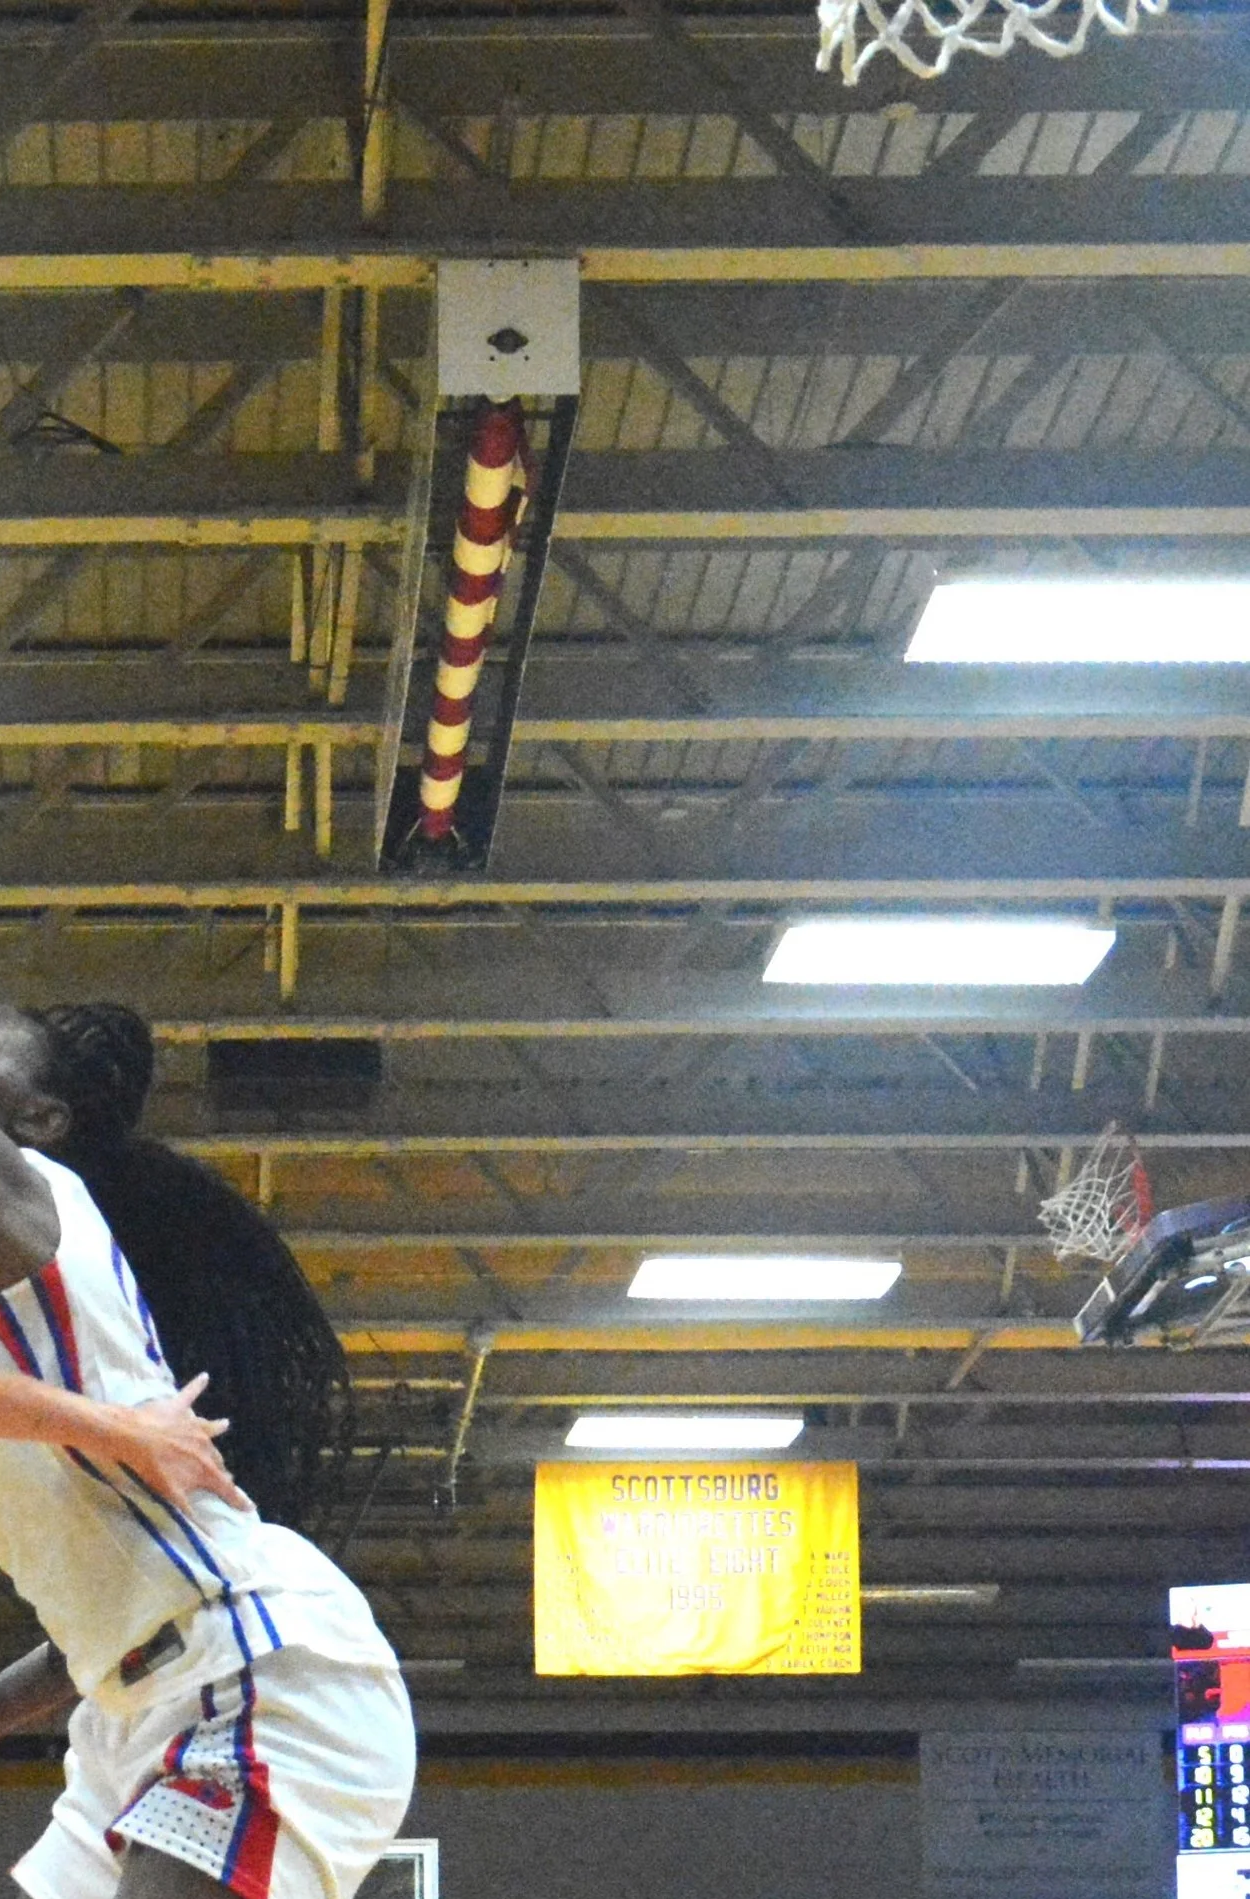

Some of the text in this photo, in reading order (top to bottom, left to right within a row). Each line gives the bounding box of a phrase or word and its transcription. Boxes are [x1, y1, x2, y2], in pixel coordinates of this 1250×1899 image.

[612, 1474, 779, 1501] SCOTTSBURG
[710, 1548, 779, 1574] EIGHT
[668, 1585, 723, 1610] 1995
